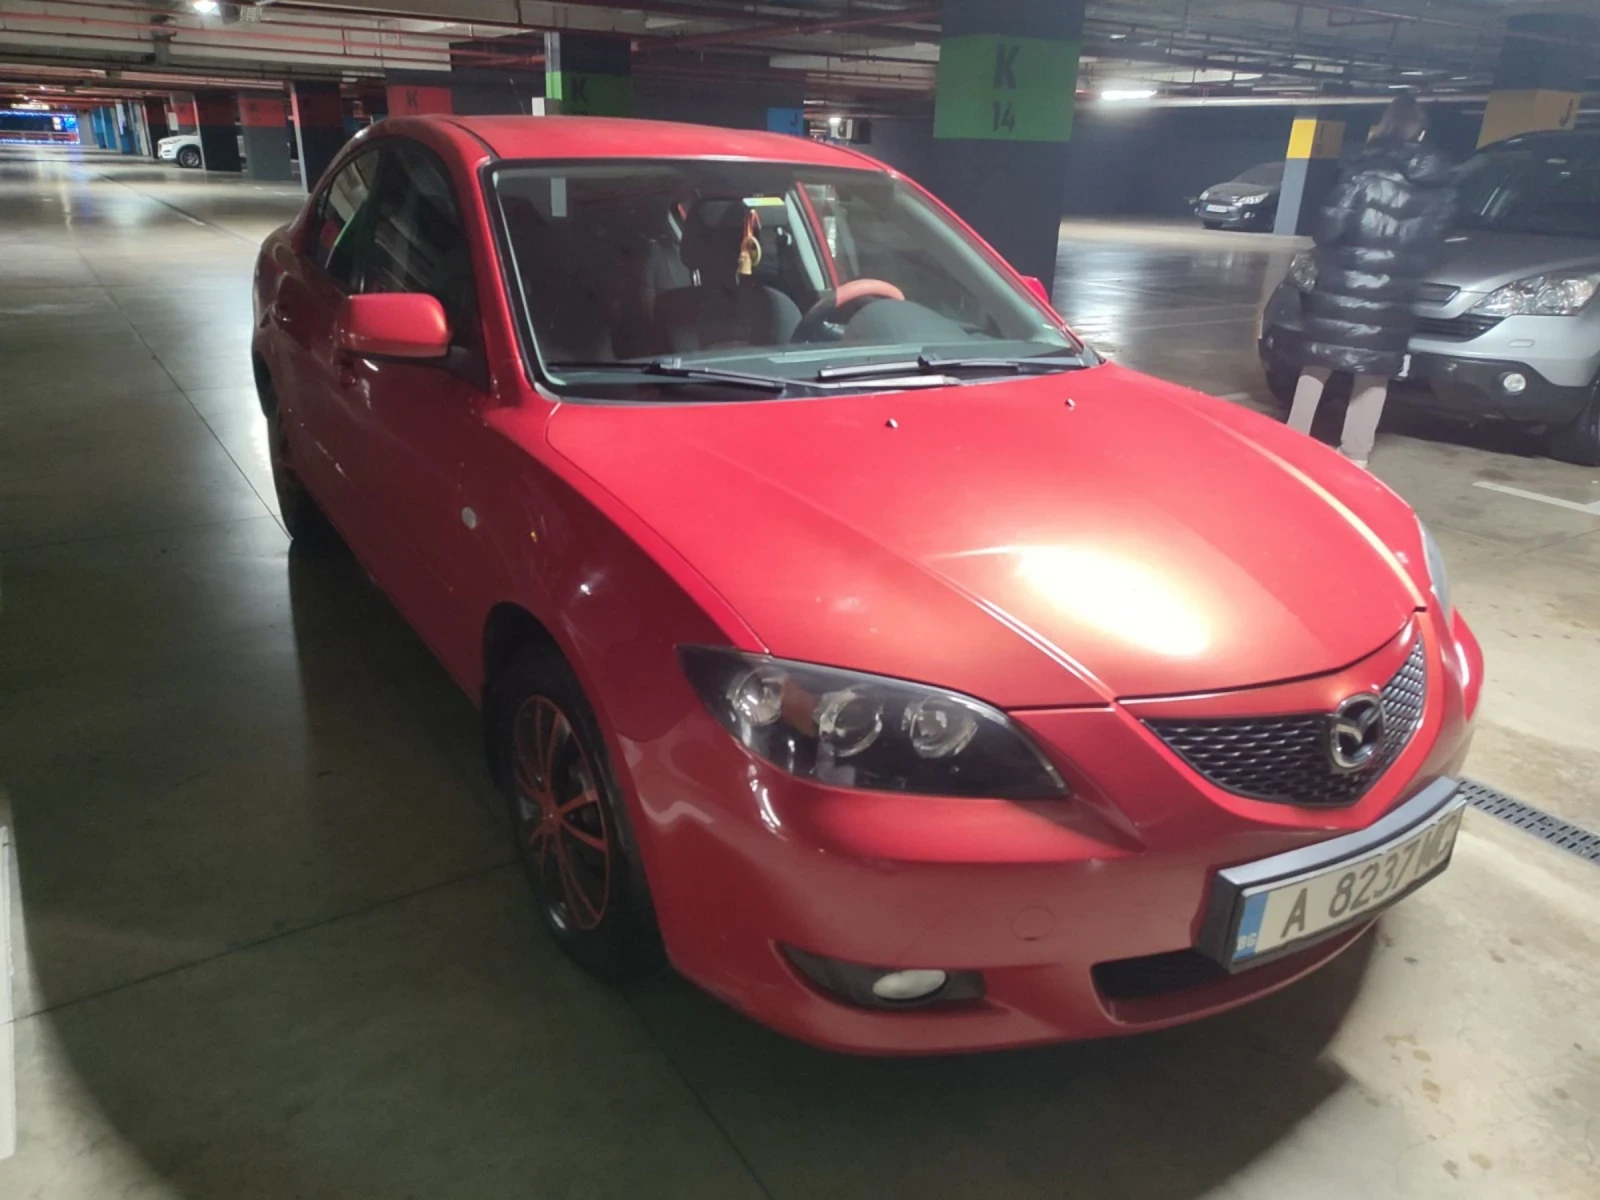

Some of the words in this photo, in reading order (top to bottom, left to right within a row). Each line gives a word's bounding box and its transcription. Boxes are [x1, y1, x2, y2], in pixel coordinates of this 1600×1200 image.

[992, 43, 1021, 89] K
[404, 89, 418, 108] K
[572, 76, 588, 105] K
[789, 111, 798, 127] J
[992, 99, 1016, 132] 14
[1559, 98, 1574, 127] J
[1280, 887, 1308, 939] A
